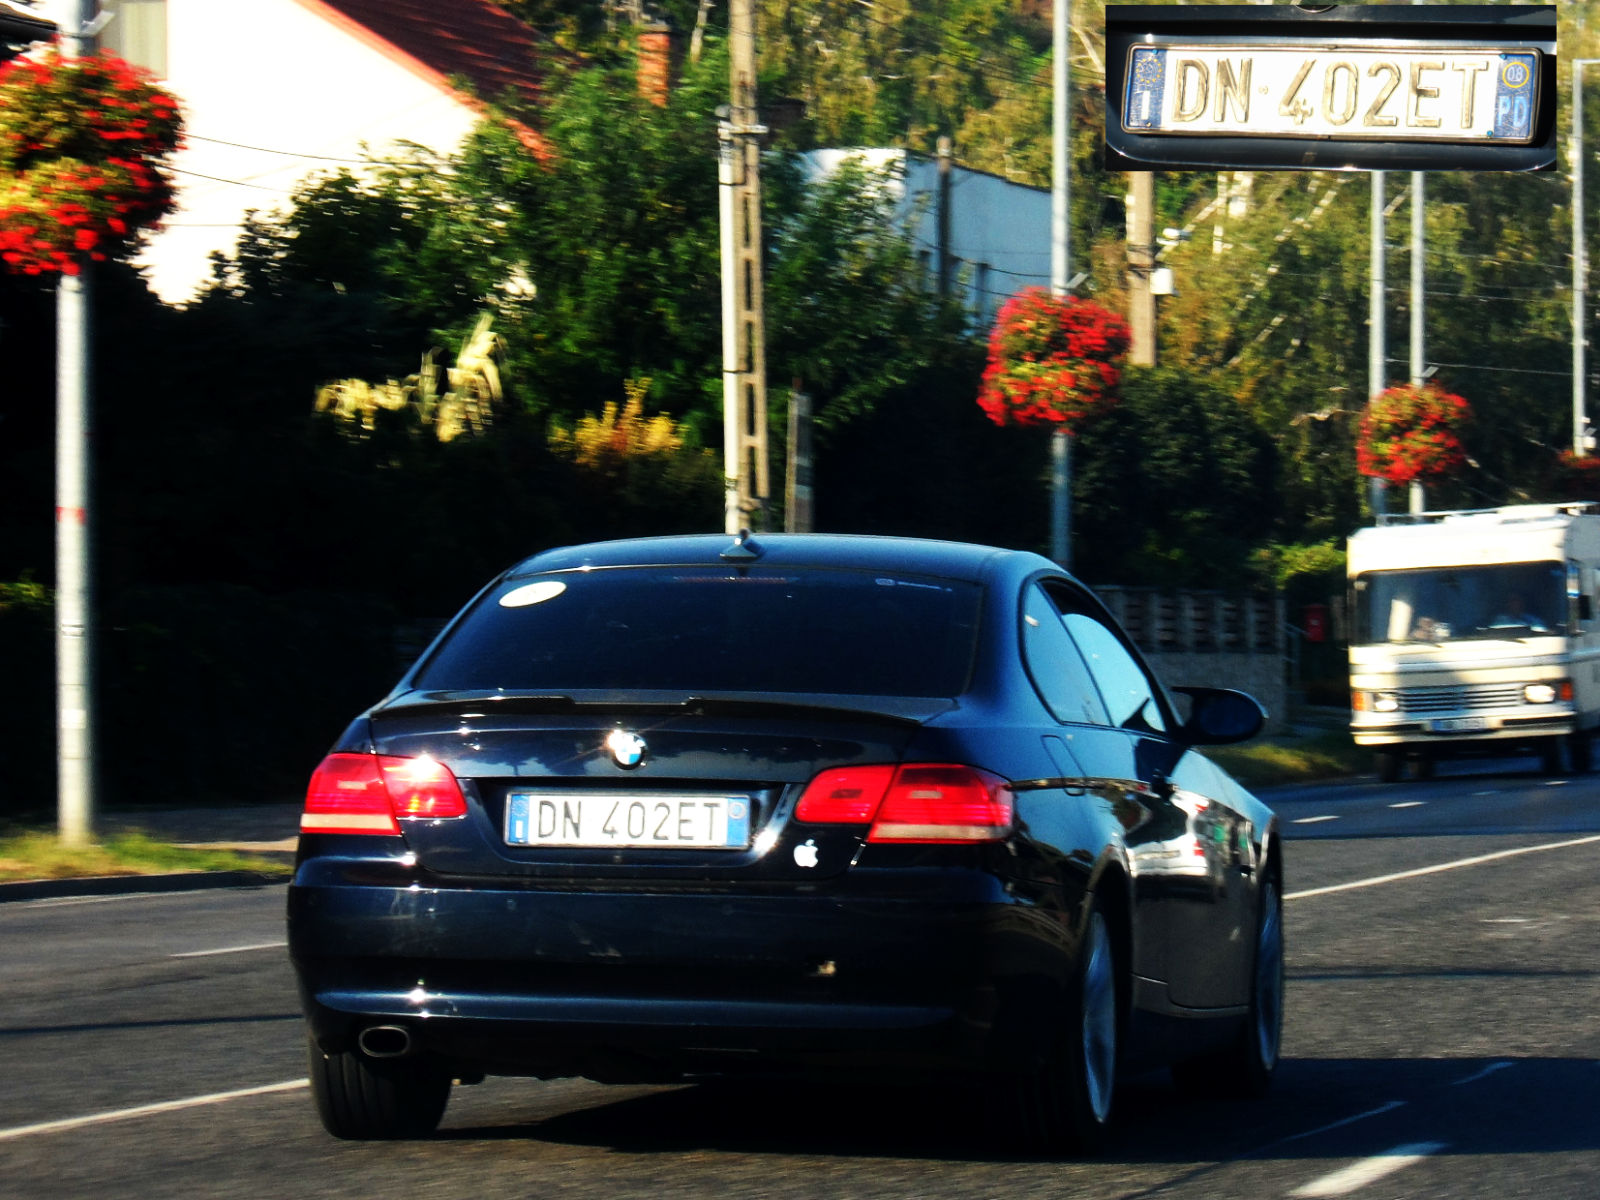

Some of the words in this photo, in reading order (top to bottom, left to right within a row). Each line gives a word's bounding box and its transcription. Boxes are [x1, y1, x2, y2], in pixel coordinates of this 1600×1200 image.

[1172, 58, 1252, 123] DN
[1278, 58, 1489, 129] 402ET
[1497, 95, 1528, 127] PD
[538, 800, 582, 839] DN
[602, 801, 721, 840] 402ET
